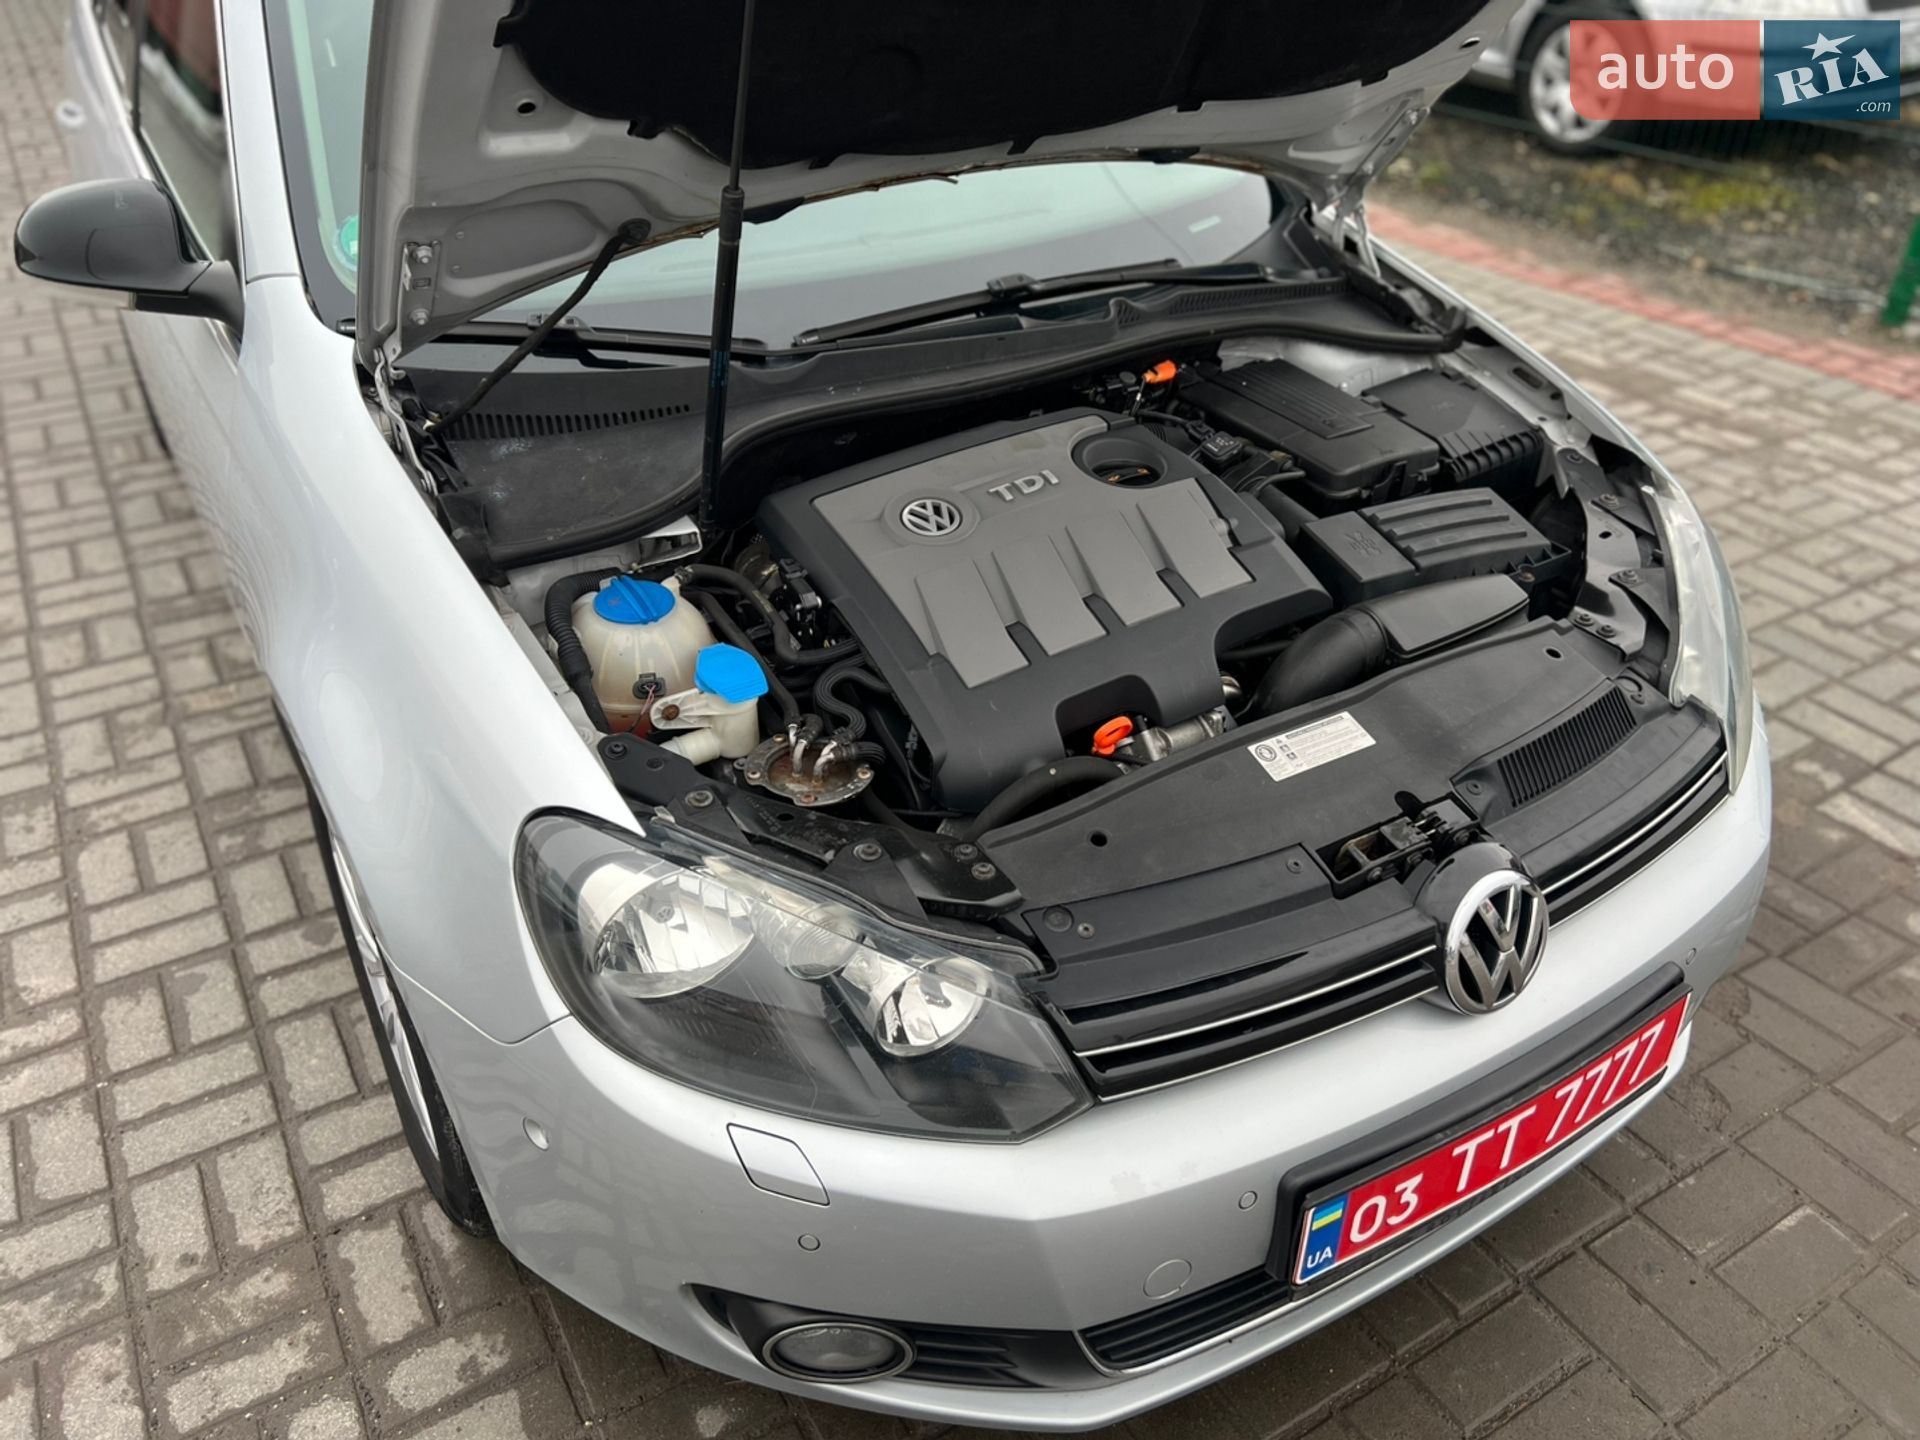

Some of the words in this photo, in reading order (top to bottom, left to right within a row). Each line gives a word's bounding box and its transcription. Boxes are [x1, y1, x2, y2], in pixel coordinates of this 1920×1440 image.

[989, 470, 1060, 502] TDI
[1349, 1174, 1424, 1243] 03
[1453, 1105, 1537, 1192] TT
[1546, 1020, 1665, 1142] 7777
[1306, 1246, 1333, 1269] UA
